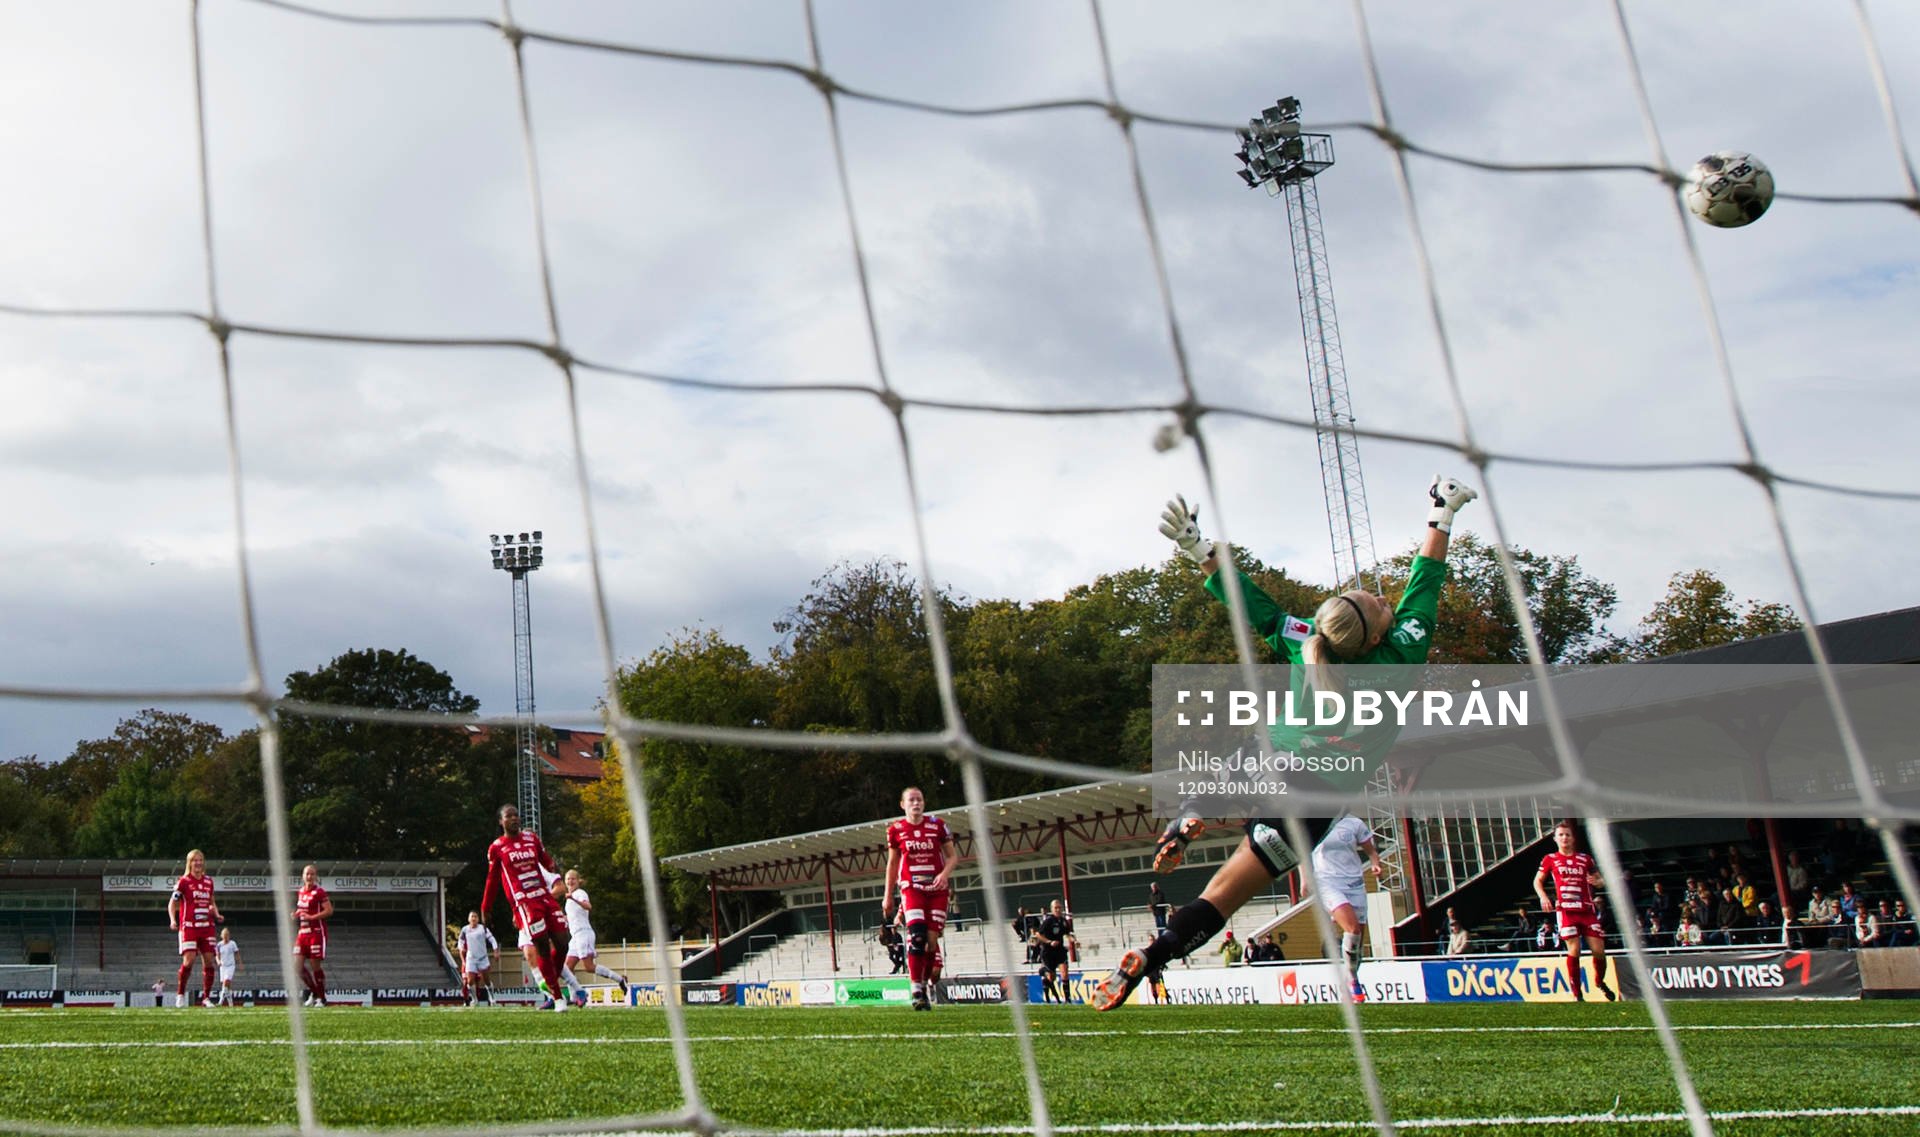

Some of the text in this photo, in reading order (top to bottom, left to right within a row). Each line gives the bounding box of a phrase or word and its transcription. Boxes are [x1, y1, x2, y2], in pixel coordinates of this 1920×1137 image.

[905, 838, 934, 851] Piteå
[508, 848, 535, 862] Piteå
[1446, 964, 1514, 997] DÄCK
[1650, 963, 1785, 989] KUMHO TYRES
[946, 983, 1002, 1000] KUMHO TYRES
[1166, 985, 1260, 1005] SVENSKA SPEL
[1301, 982, 1415, 1003] SVENA SPEL
